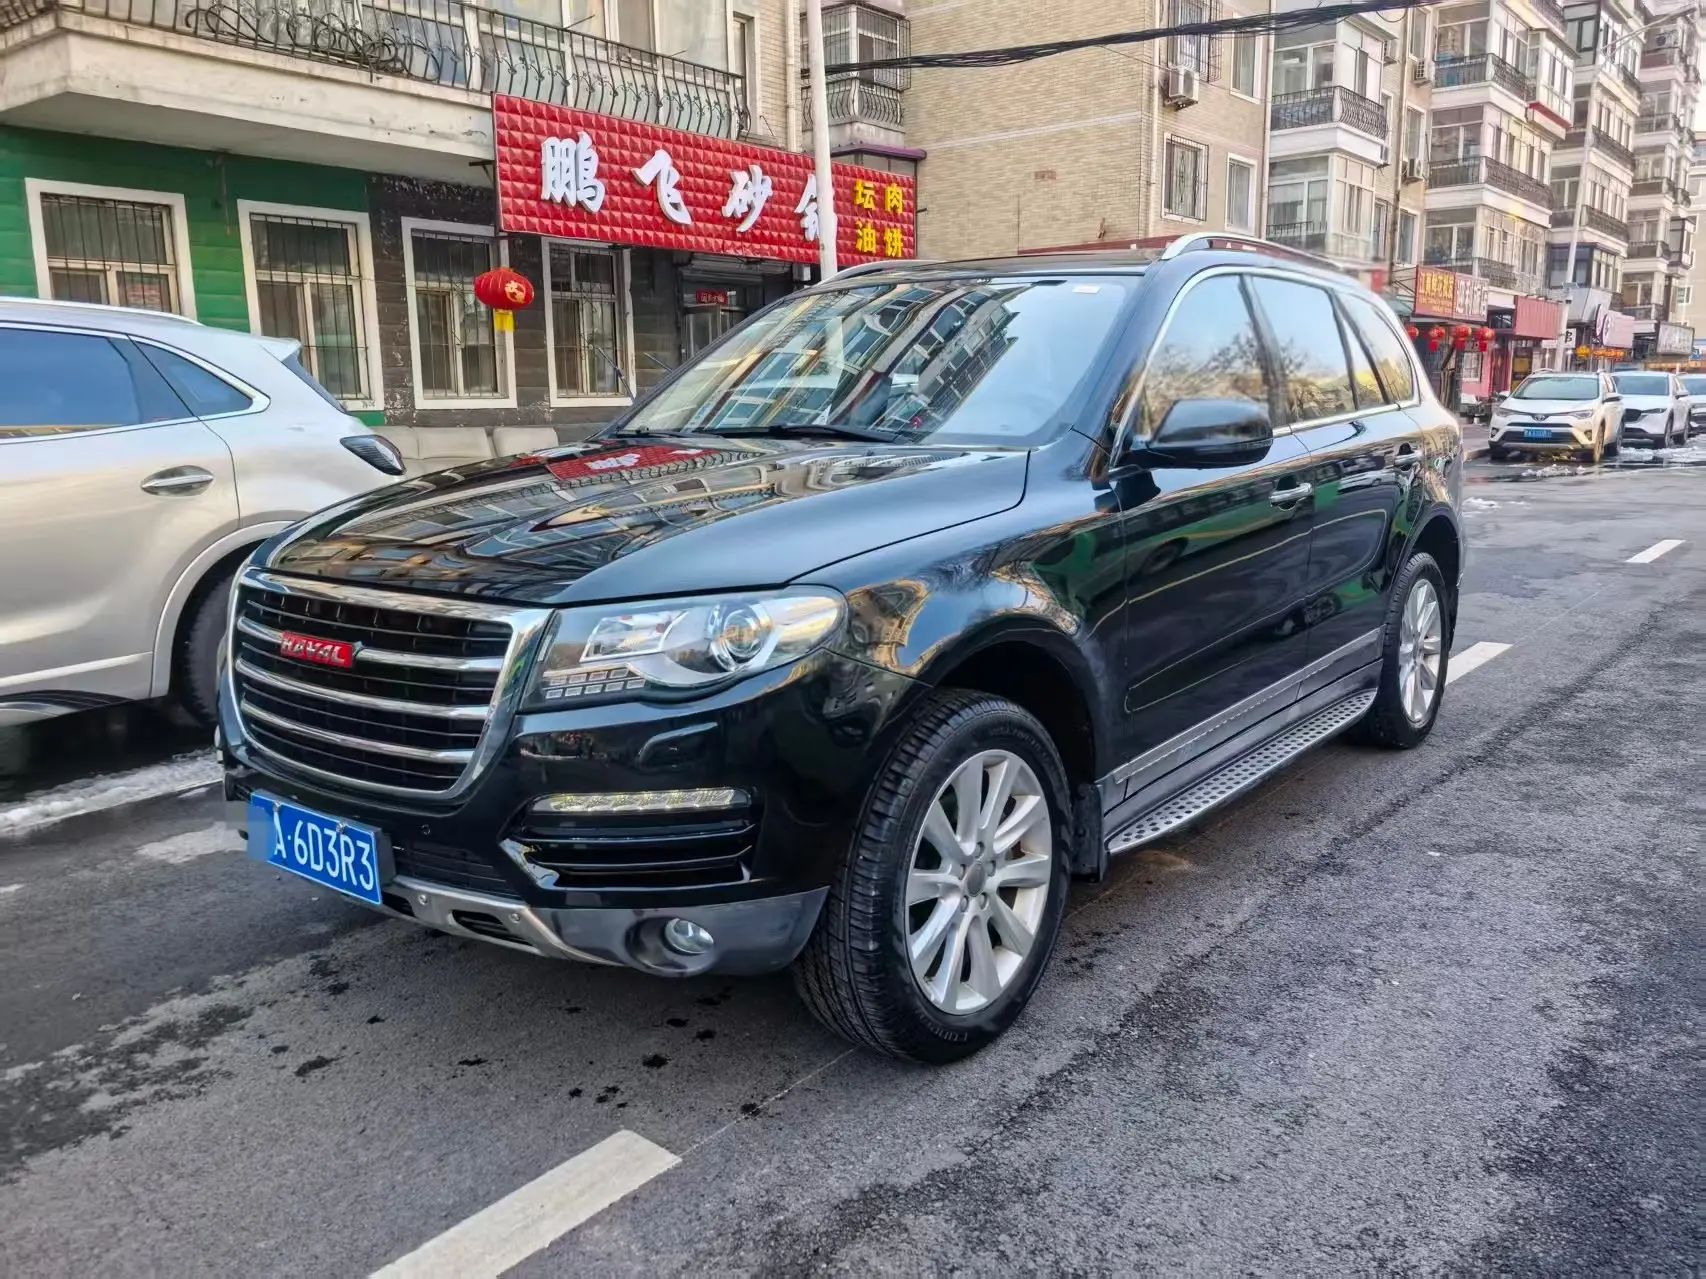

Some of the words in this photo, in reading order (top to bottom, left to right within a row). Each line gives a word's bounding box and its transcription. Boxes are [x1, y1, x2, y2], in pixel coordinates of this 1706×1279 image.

[854, 179, 903, 215] 坛肉
[855, 220, 904, 257] 油饼
[281, 637, 345, 665] HAVAL
